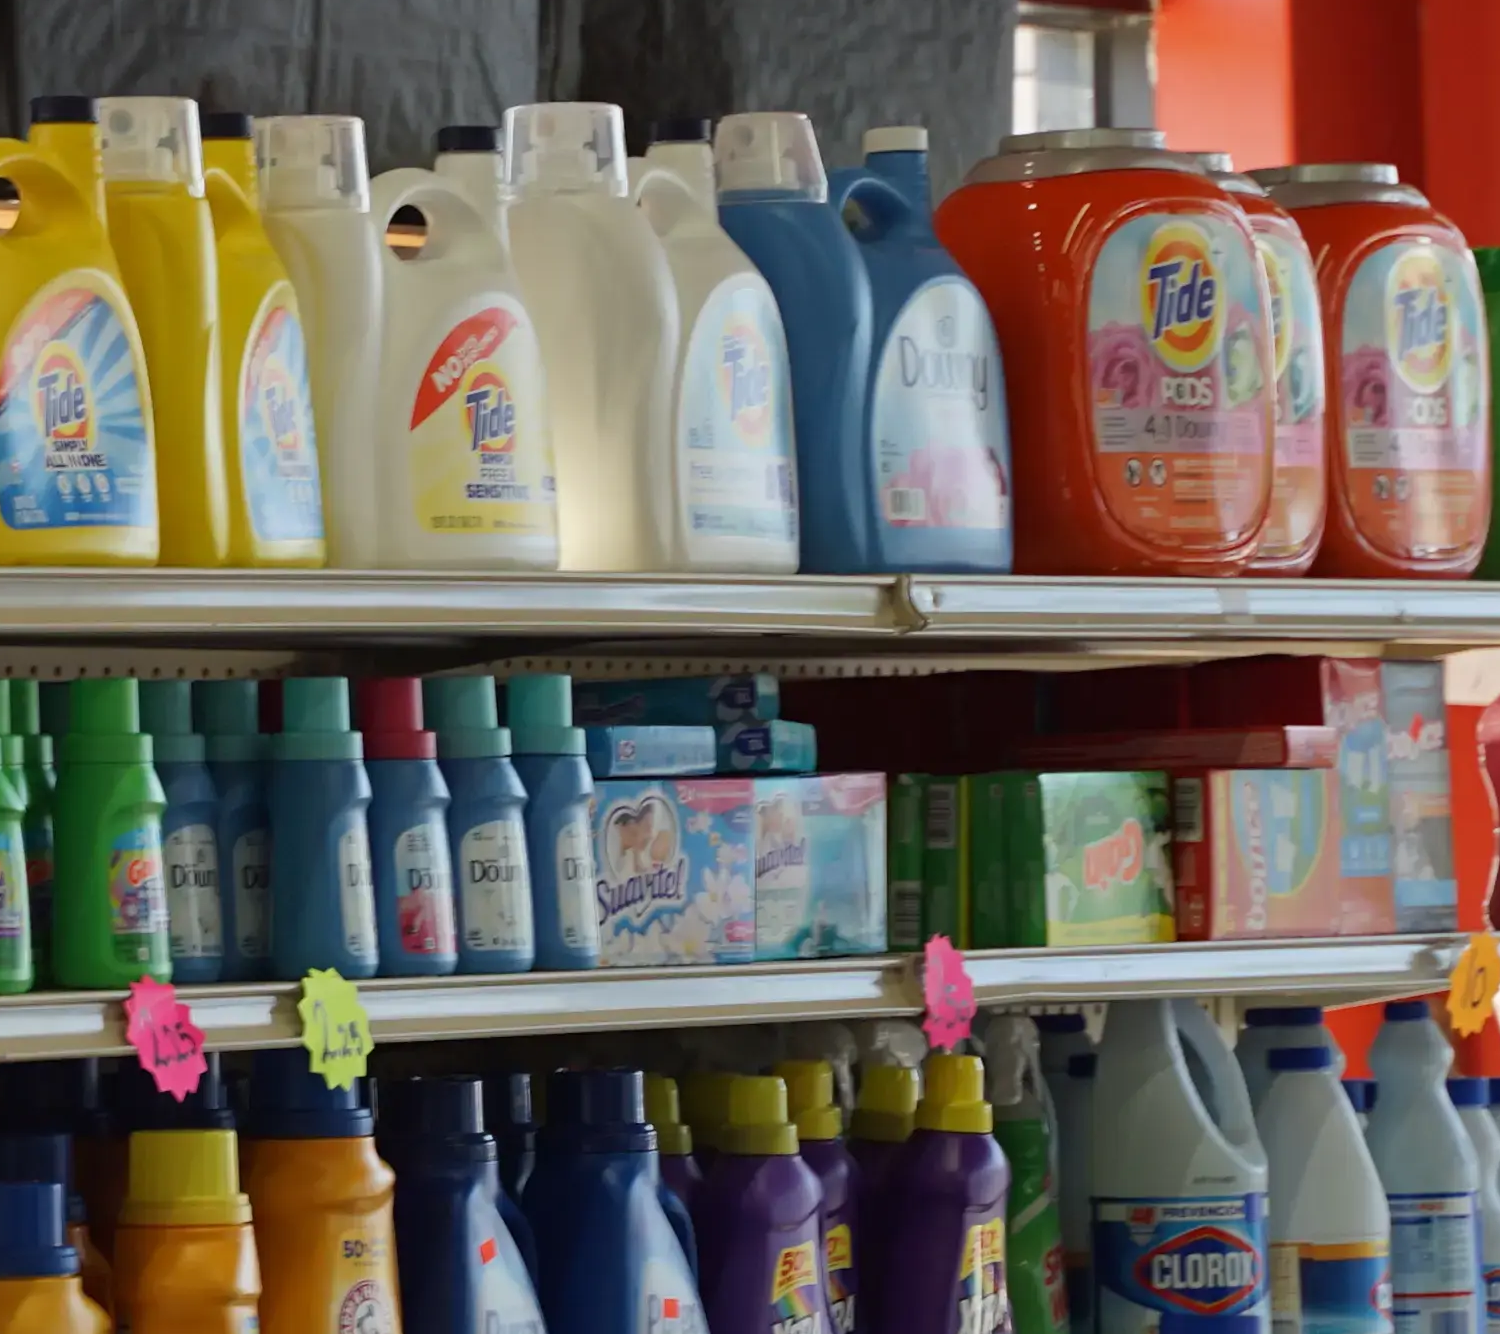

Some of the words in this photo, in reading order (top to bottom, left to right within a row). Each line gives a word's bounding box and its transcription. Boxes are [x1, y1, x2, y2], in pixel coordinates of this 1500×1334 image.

[1148, 259, 1216, 345] Tide
[1393, 286, 1448, 362] Tide
[37, 371, 87, 438] Tide
[431, 357, 465, 393] NO
[899, 334, 989, 413] Downy
[1160, 376, 1215, 407] PODS
[465, 388, 517, 452] Tide
[128, 859, 158, 886] Ga
[170, 864, 218, 889] Dow
[1244, 781, 1271, 934] bounce
[597, 857, 685, 927] Suavitel
[1150, 1253, 1254, 1290] CLOROX
